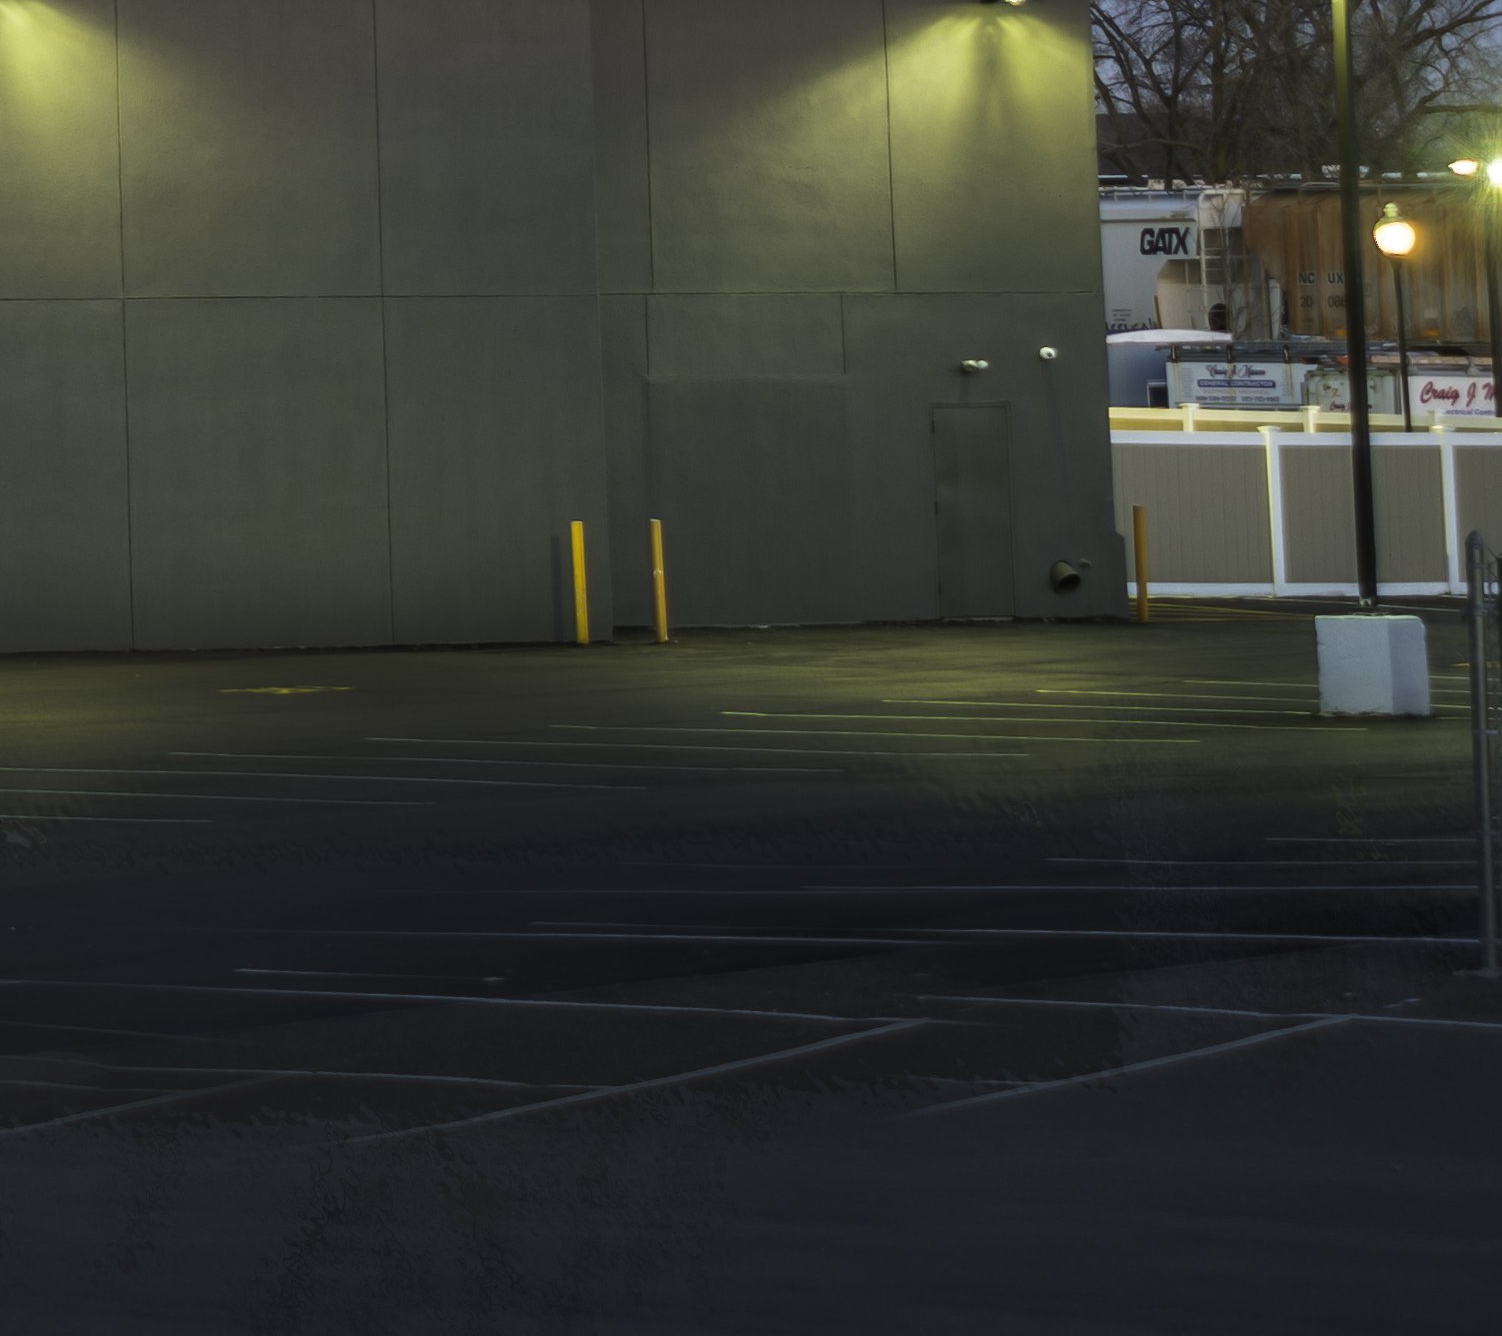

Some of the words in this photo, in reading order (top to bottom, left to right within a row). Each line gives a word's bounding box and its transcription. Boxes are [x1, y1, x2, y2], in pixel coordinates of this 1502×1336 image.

[1140, 227, 1190, 256] GATX
[1419, 380, 1460, 406] Craig
[1465, 382, 1477, 408] J
